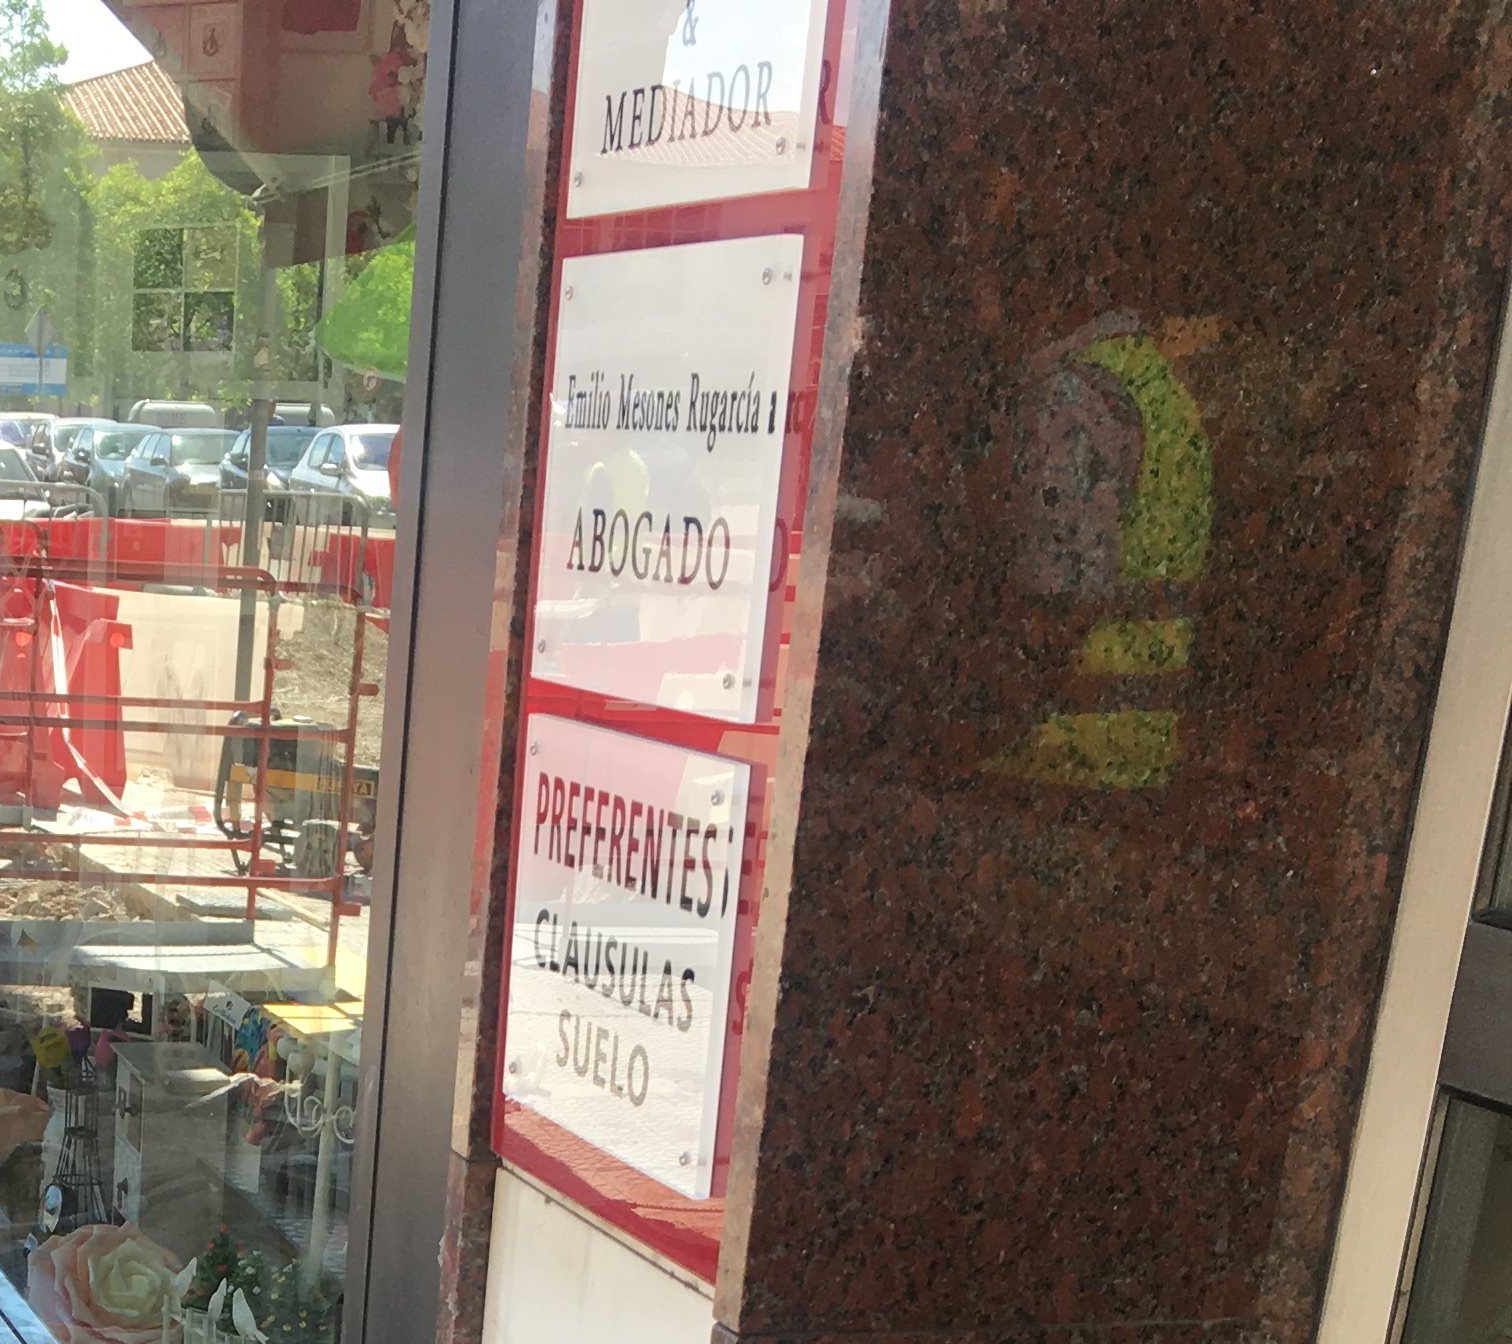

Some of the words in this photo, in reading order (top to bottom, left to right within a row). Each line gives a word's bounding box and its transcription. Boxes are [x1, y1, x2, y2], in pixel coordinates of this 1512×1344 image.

[600, 60, 773, 155] MEDIADOR
[565, 369, 611, 430] Emilio
[616, 373, 680, 432] Mesones
[686, 370, 761, 453] Rugarcía
[566, 505, 731, 590] ABOGADO
[534, 771, 717, 918] PREFERENTES
[534, 908, 695, 1032] CLAUSULAS
[556, 1008, 650, 1107] SUELO
